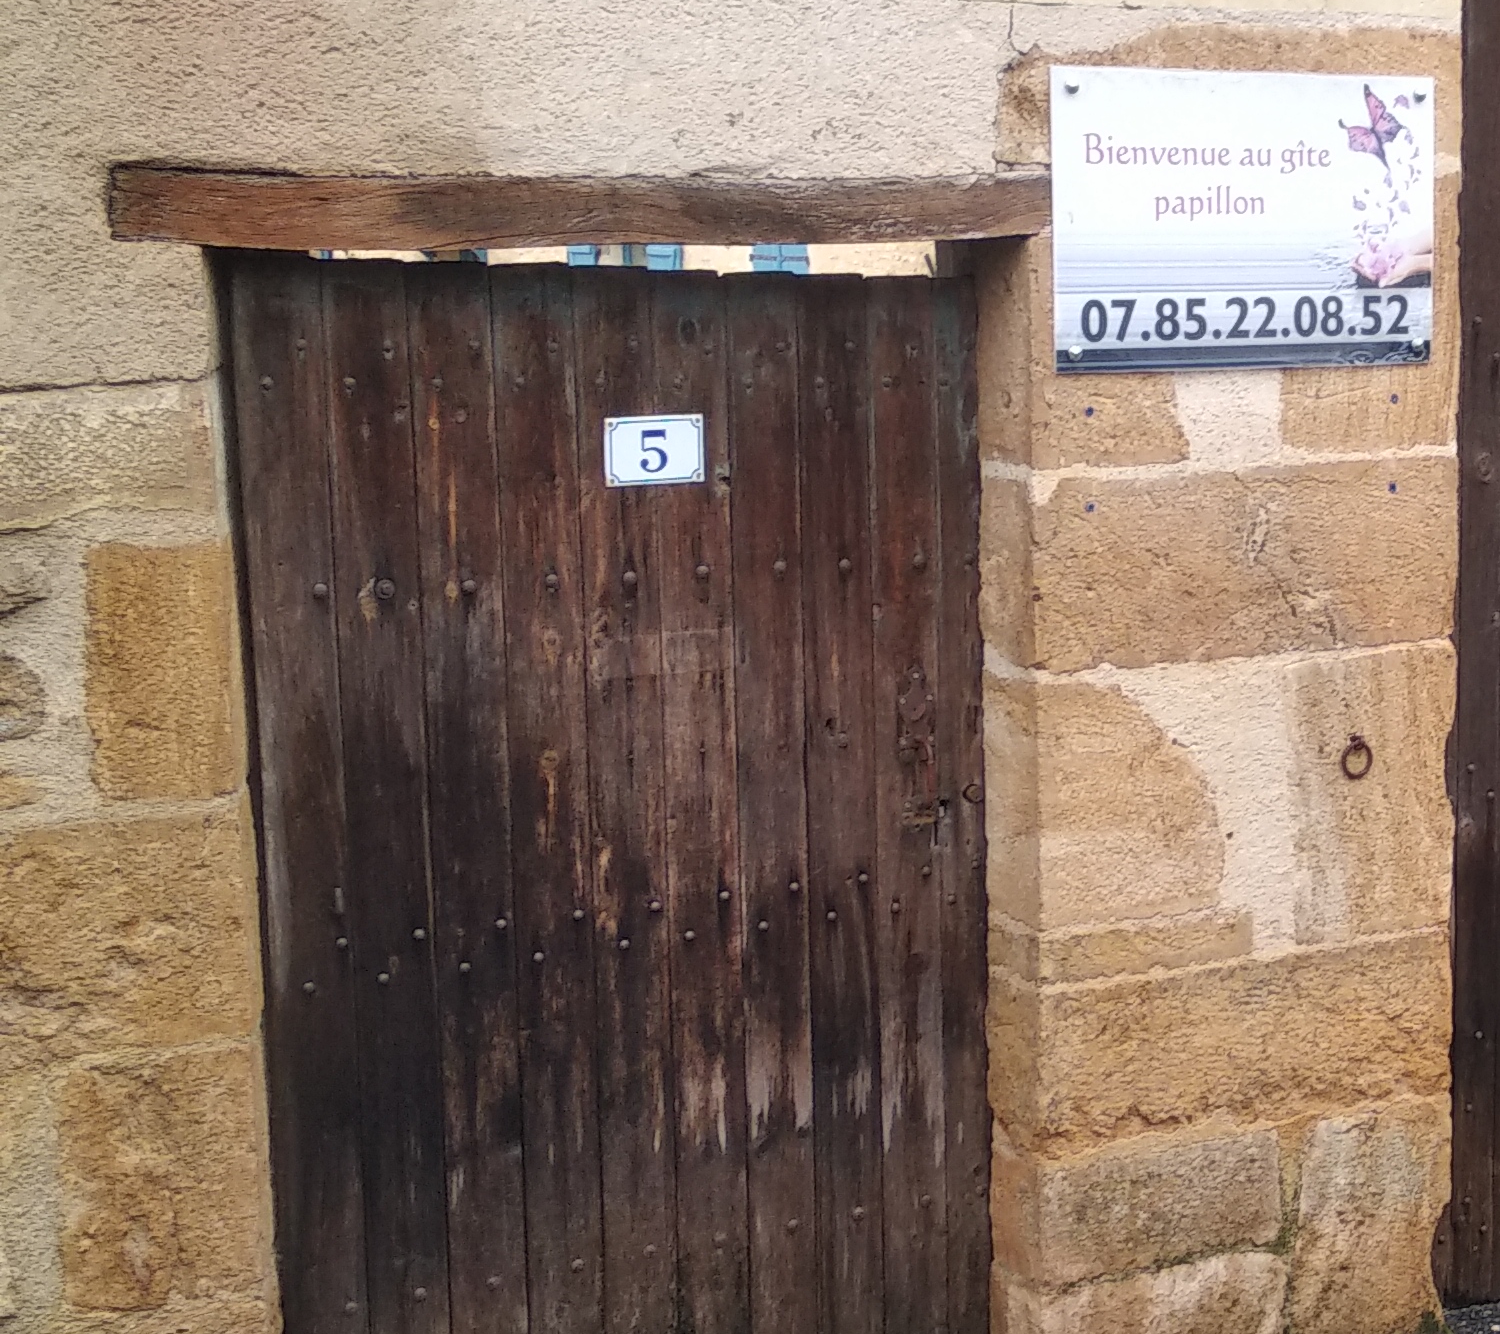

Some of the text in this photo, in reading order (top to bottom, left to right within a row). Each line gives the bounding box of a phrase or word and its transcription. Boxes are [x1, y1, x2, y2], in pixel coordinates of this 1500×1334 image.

[1082, 132, 1332, 175] Bienvenue au gîte
[1154, 185, 1266, 221] papillon
[1080, 295, 1411, 342] 07.85.22.08.52
[639, 429, 668, 473] 5
